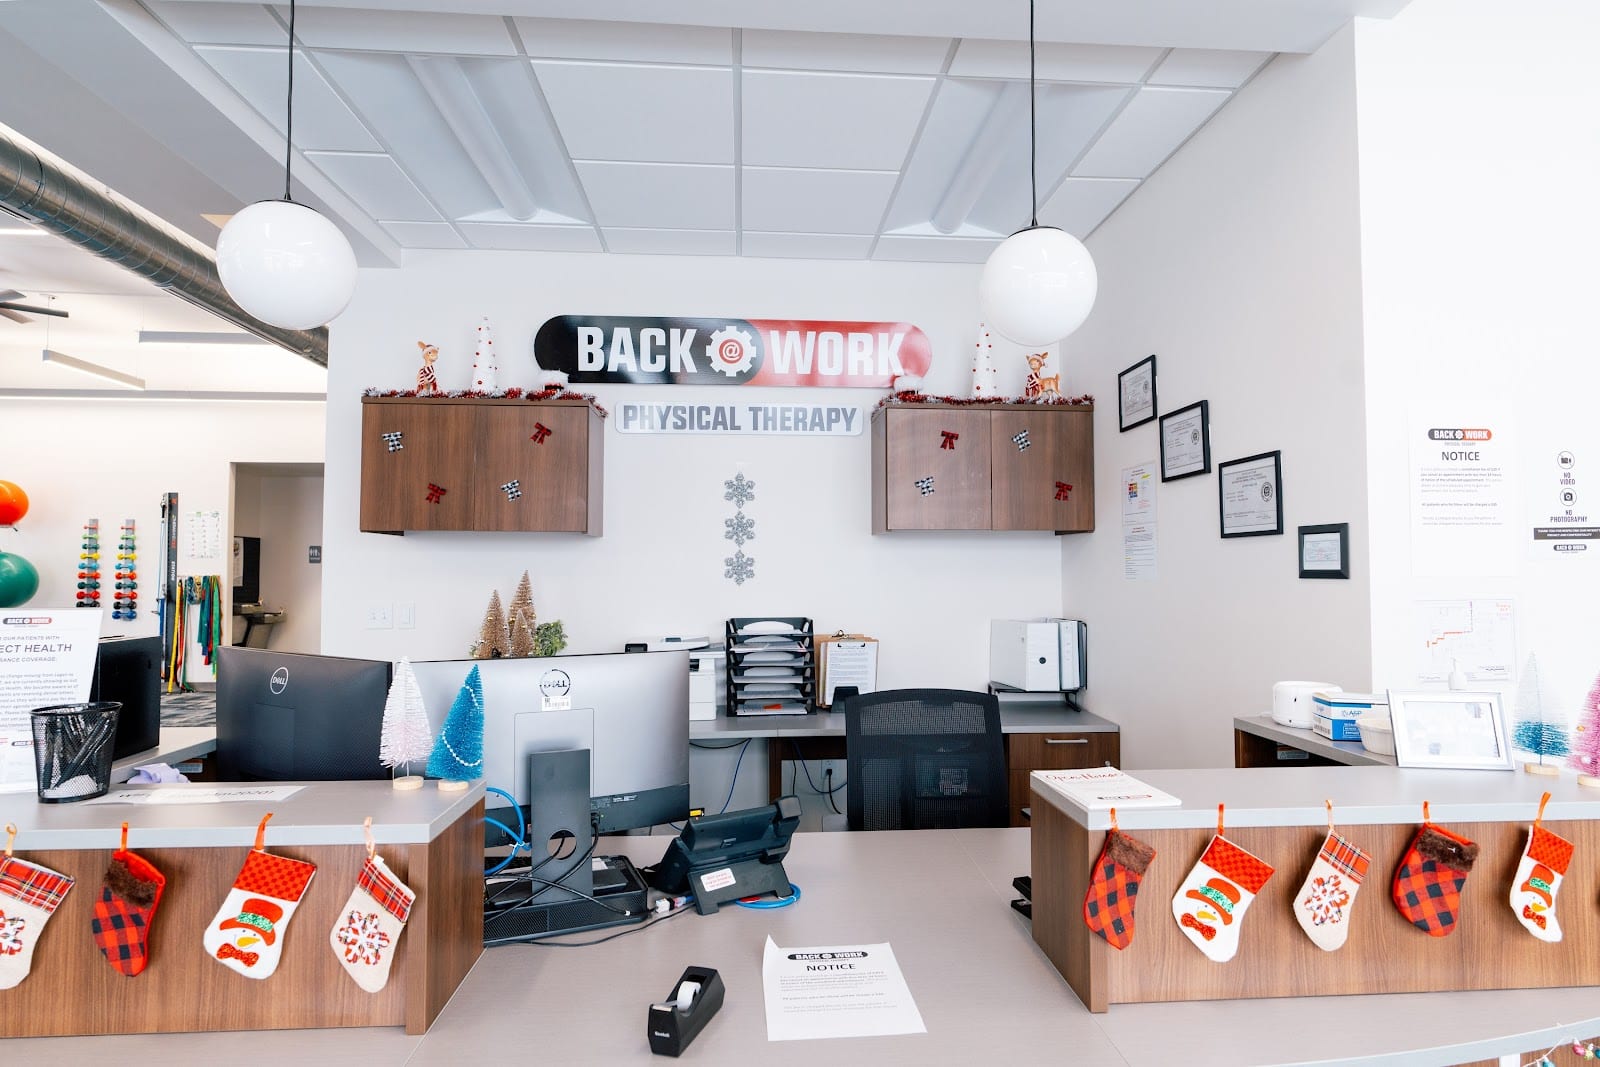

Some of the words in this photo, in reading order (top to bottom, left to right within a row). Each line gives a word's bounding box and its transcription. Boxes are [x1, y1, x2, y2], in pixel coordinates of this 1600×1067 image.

[577, 326, 698, 373] BACK
[724, 341, 741, 361] @
[770, 330, 905, 376] WORK
[622, 404, 741, 431] PHYSICAL
[748, 406, 857, 432] THERAPY
[1434, 430, 1455, 439] BACK
[1465, 430, 1488, 440] WORK
[1441, 451, 1481, 461] NOTICE
[24, 644, 72, 653] HEALTH
[795, 953, 821, 961] BACK
[834, 951, 863, 959] WORK
[806, 963, 856, 972] NOTICE
